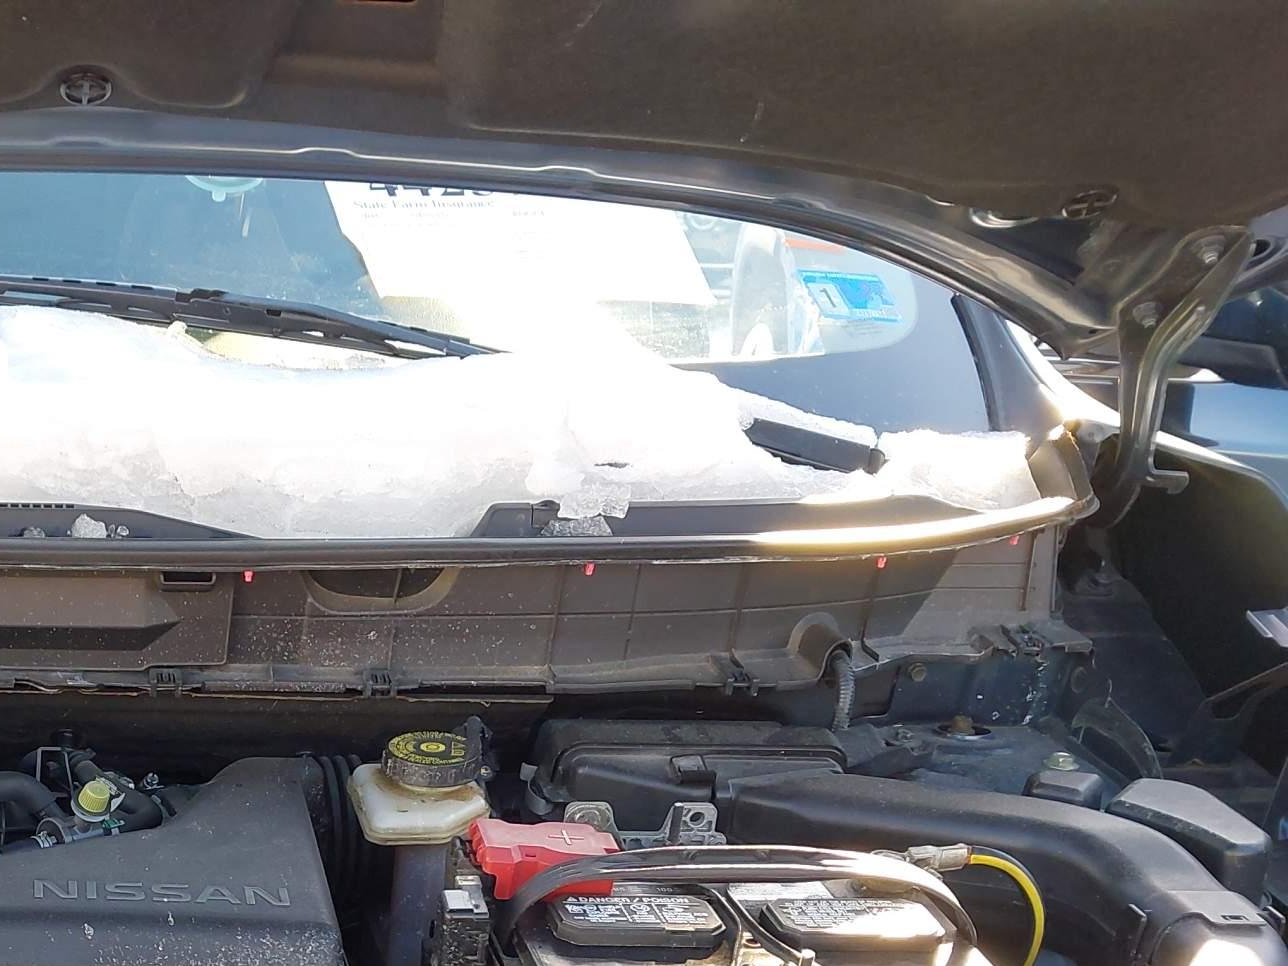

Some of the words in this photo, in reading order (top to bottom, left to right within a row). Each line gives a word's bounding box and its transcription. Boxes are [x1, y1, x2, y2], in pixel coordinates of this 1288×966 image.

[33, 879, 292, 907] NISSAN
[578, 896, 629, 904] DANGER
[641, 896, 689, 904] POISON
